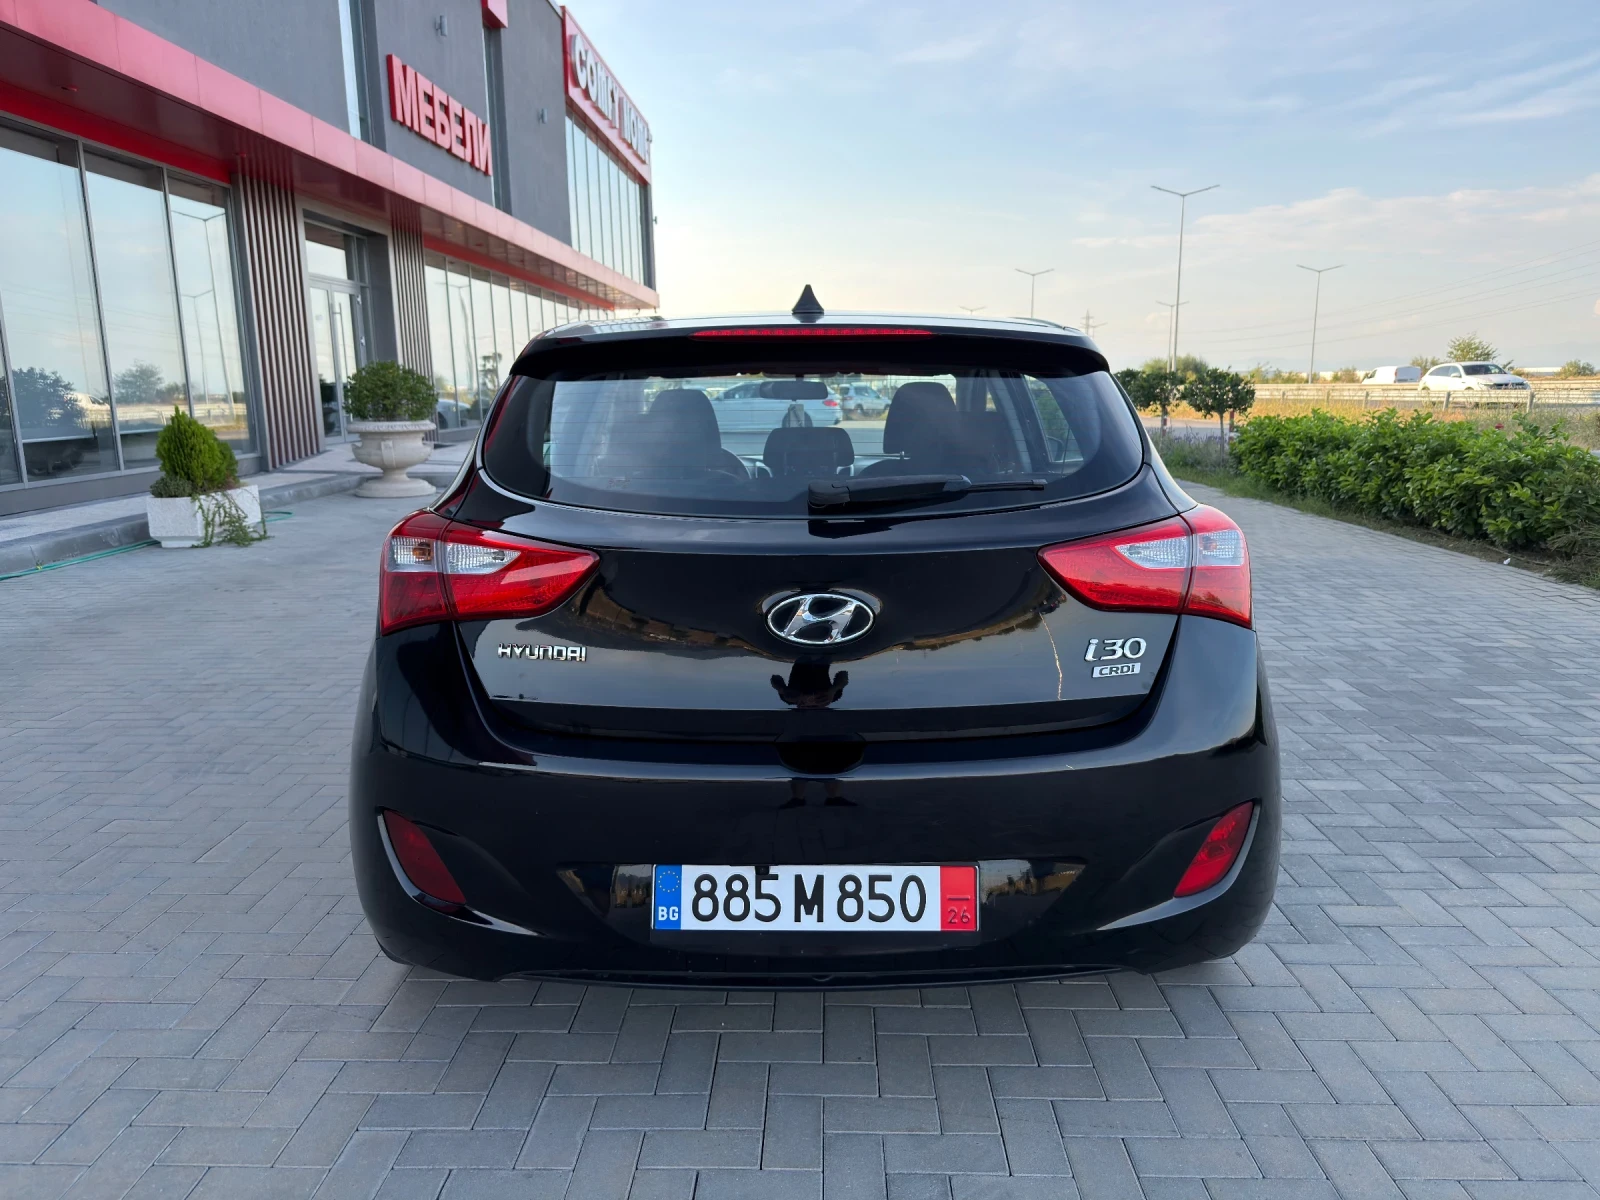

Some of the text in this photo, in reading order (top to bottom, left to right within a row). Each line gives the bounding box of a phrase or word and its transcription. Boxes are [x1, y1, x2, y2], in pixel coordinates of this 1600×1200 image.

[387, 53, 492, 176] МЕБЕЛИ
[498, 643, 587, 662] HYUNDAI
[1084, 637, 1147, 661] i30
[692, 873, 926, 923] 885 M 850
[658, 907, 679, 921] BG
[948, 906, 971, 924] 26
